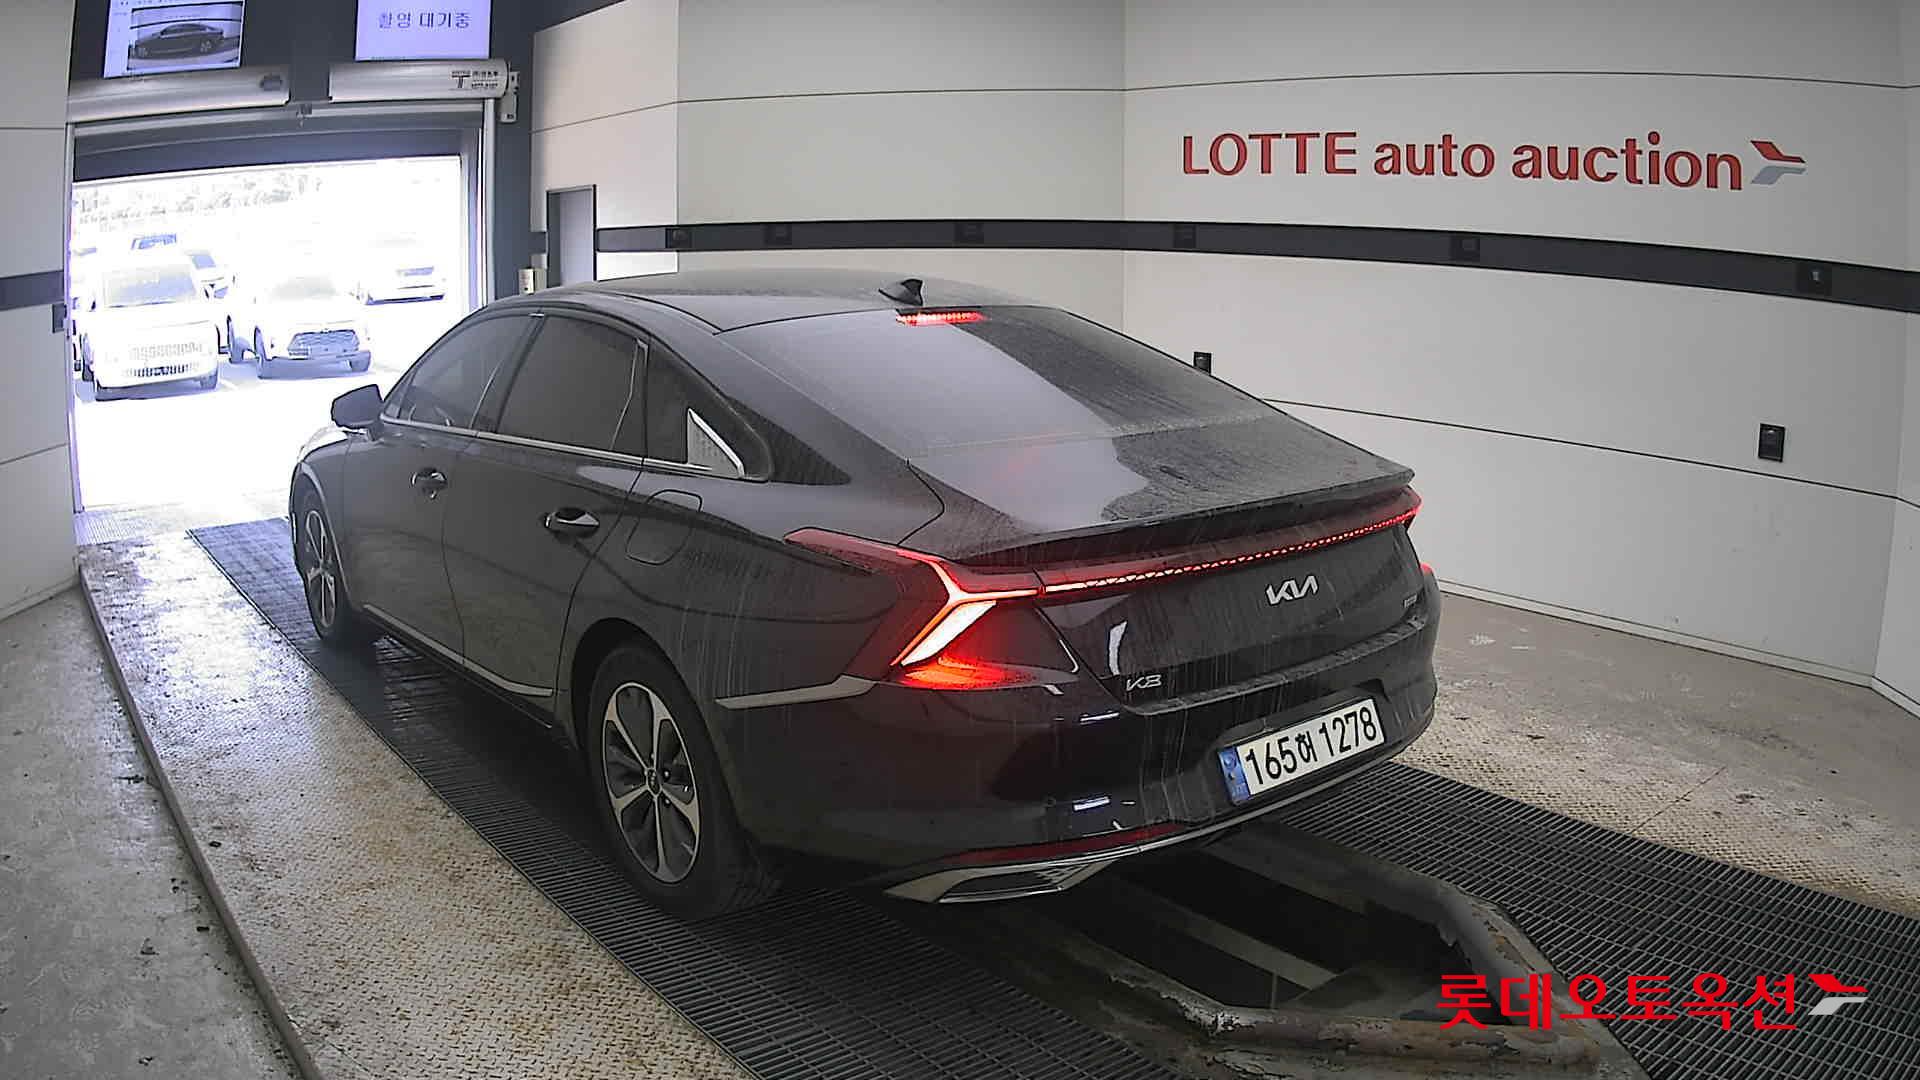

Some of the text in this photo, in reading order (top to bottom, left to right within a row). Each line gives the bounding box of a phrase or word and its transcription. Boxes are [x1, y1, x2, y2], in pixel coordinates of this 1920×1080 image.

[419, 11, 472, 29] 대기중
[1183, 131, 1742, 190] LOTTE auto auction
[1265, 575, 1319, 605] KIA
[1126, 674, 1162, 692] K8
[1246, 707, 1377, 785] 165허 1278
